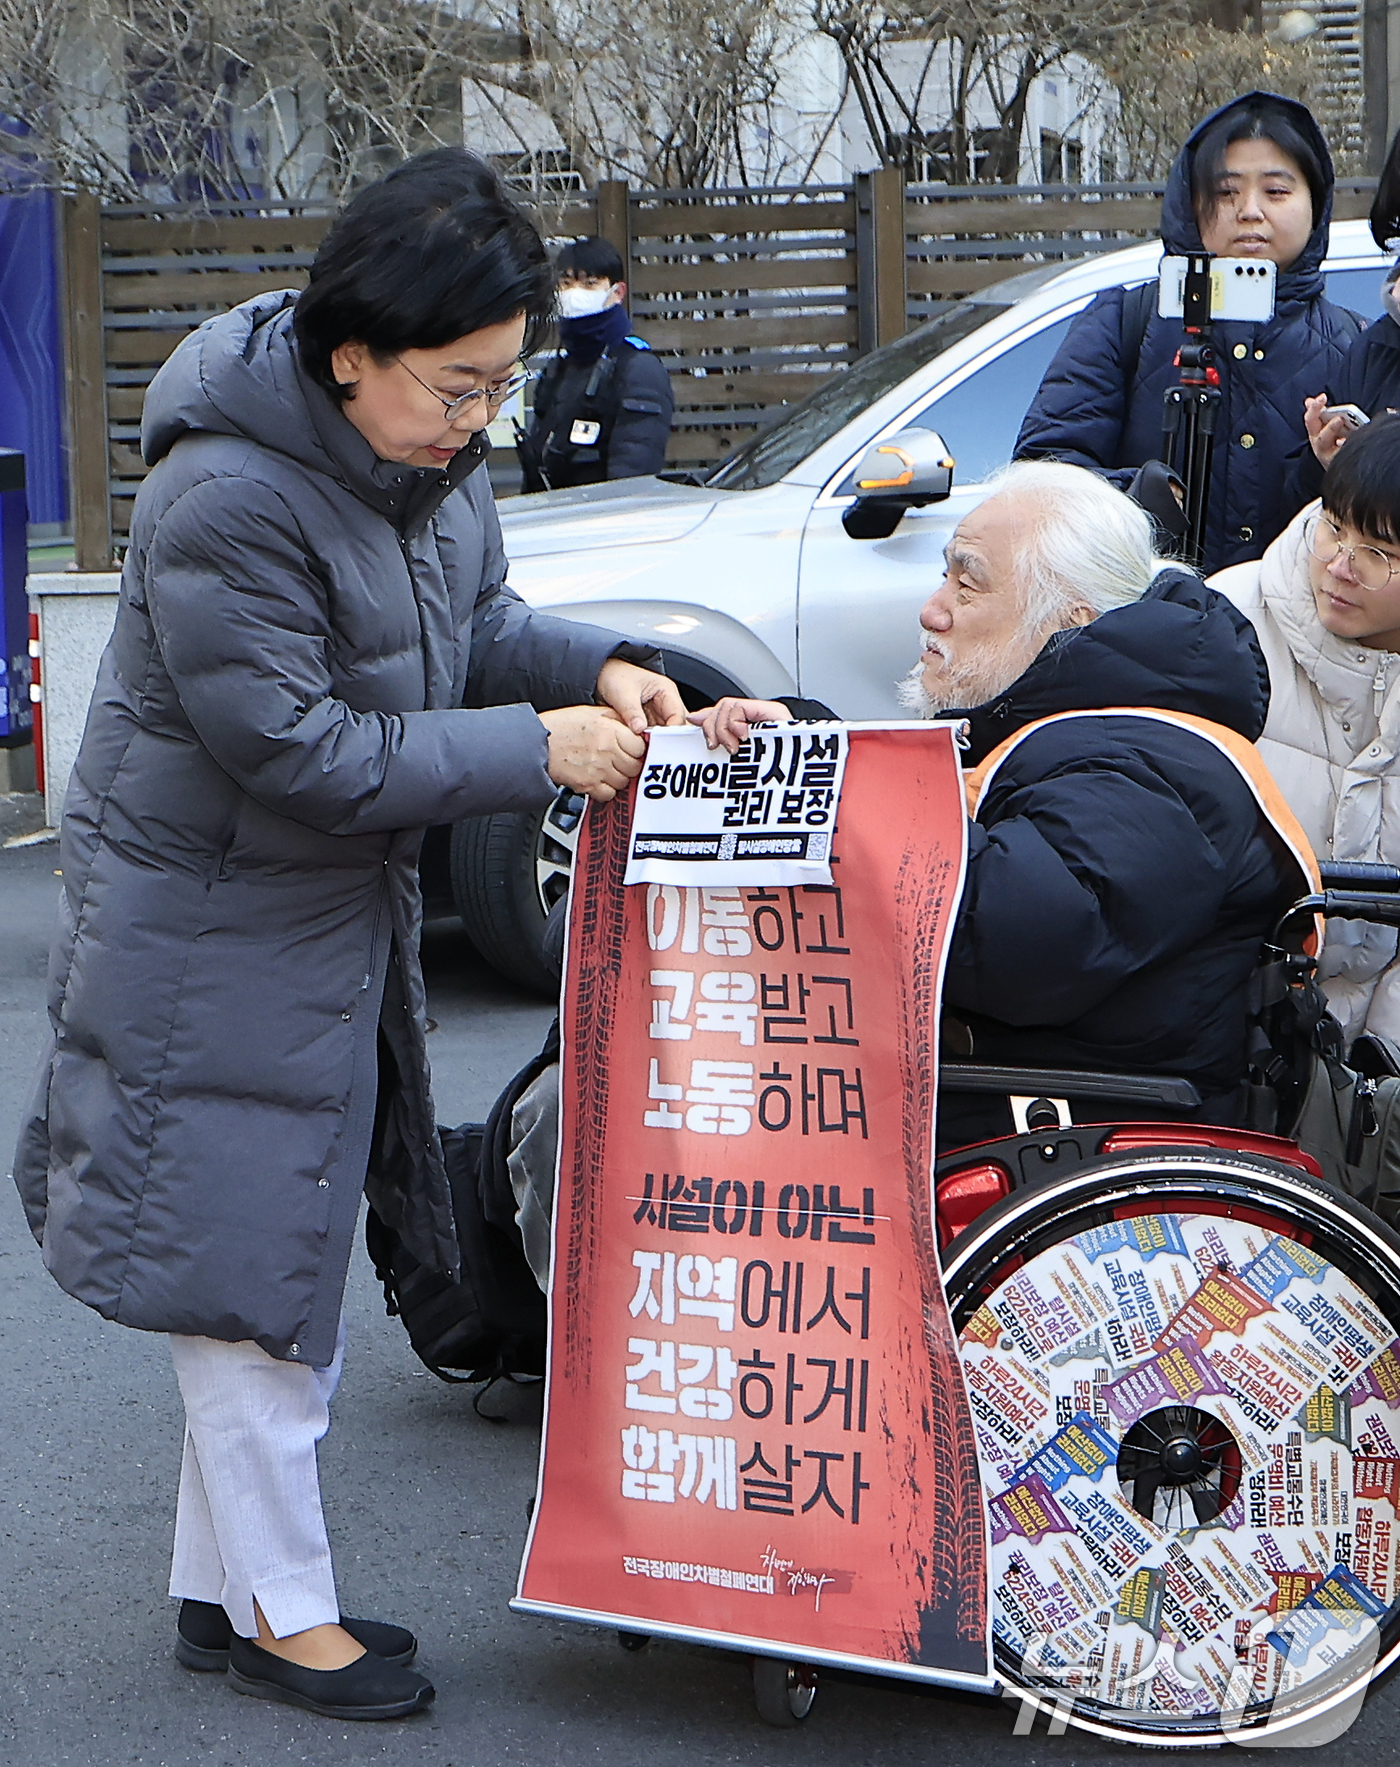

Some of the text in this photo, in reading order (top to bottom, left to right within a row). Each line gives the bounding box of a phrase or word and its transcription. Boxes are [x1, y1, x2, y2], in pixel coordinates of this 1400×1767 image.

[643, 734, 839, 799] 장애인 탈시설
[722, 788, 834, 827] 권리 보장
[646, 884, 851, 957] 이동하고
[649, 969, 859, 1046] 교육받고
[643, 1057, 868, 1139] 노동하며
[633, 1173, 876, 1245] 시설이 아닌
[1274, 1234, 1321, 1279] 권리없다
[628, 1250, 870, 1339] 지역에서
[1002, 1283, 1055, 1355] 6224억으로
[1047, 1294, 1082, 1338] 탈시설
[1102, 1257, 1139, 1322] 교육시설
[1125, 1320, 1151, 1355] 국비
[1193, 1289, 1240, 1331] 권리없다
[1203, 1278, 1249, 1319] 예산없이
[1305, 1291, 1378, 1361] 장애인평생
[993, 1300, 1041, 1364] 보장하라!!
[1042, 1316, 1068, 1347] 예산
[1278, 1292, 1337, 1348] 교육시설
[1327, 1340, 1363, 1374] 국비
[625, 1337, 869, 1432] 건강하게
[977, 1351, 1049, 1424] 하루24시간
[1154, 1352, 1194, 1402] 권리없다
[1167, 1345, 1206, 1393] 예산없이
[1206, 1346, 1292, 1423] 활동지원예산
[1228, 1340, 1304, 1408] 하루24시간
[1053, 1432, 1098, 1477] 권리없다
[1064, 1422, 1108, 1466] 예산없이
[1014, 1483, 1050, 1531] 예산없이
[1248, 1469, 1266, 1528] 장하라!
[1269, 1495, 1285, 1527] 예산
[1285, 1431, 1303, 1527] 특별교통수단
[1001, 1490, 1039, 1539] 권리없다
[1058, 1488, 1113, 1544] 교육시설
[1106, 1535, 1139, 1569] 국비
[1084, 1487, 1153, 1557] 장애인평생
[622, 1556, 775, 1595] 전국장애인차별철폐연대
[1001, 1567, 1054, 1639] 6224억으로
[1007, 1548, 1049, 1604] 권리보장
[1042, 1601, 1067, 1631] 예산
[1046, 1580, 1081, 1623] 탈시설
[1131, 1570, 1150, 1619] 예산없이
[1161, 1540, 1236, 1624] 특별교통수단
[1154, 1589, 1205, 1646] 장하라!
[1187, 1600, 1220, 1635] 예산
